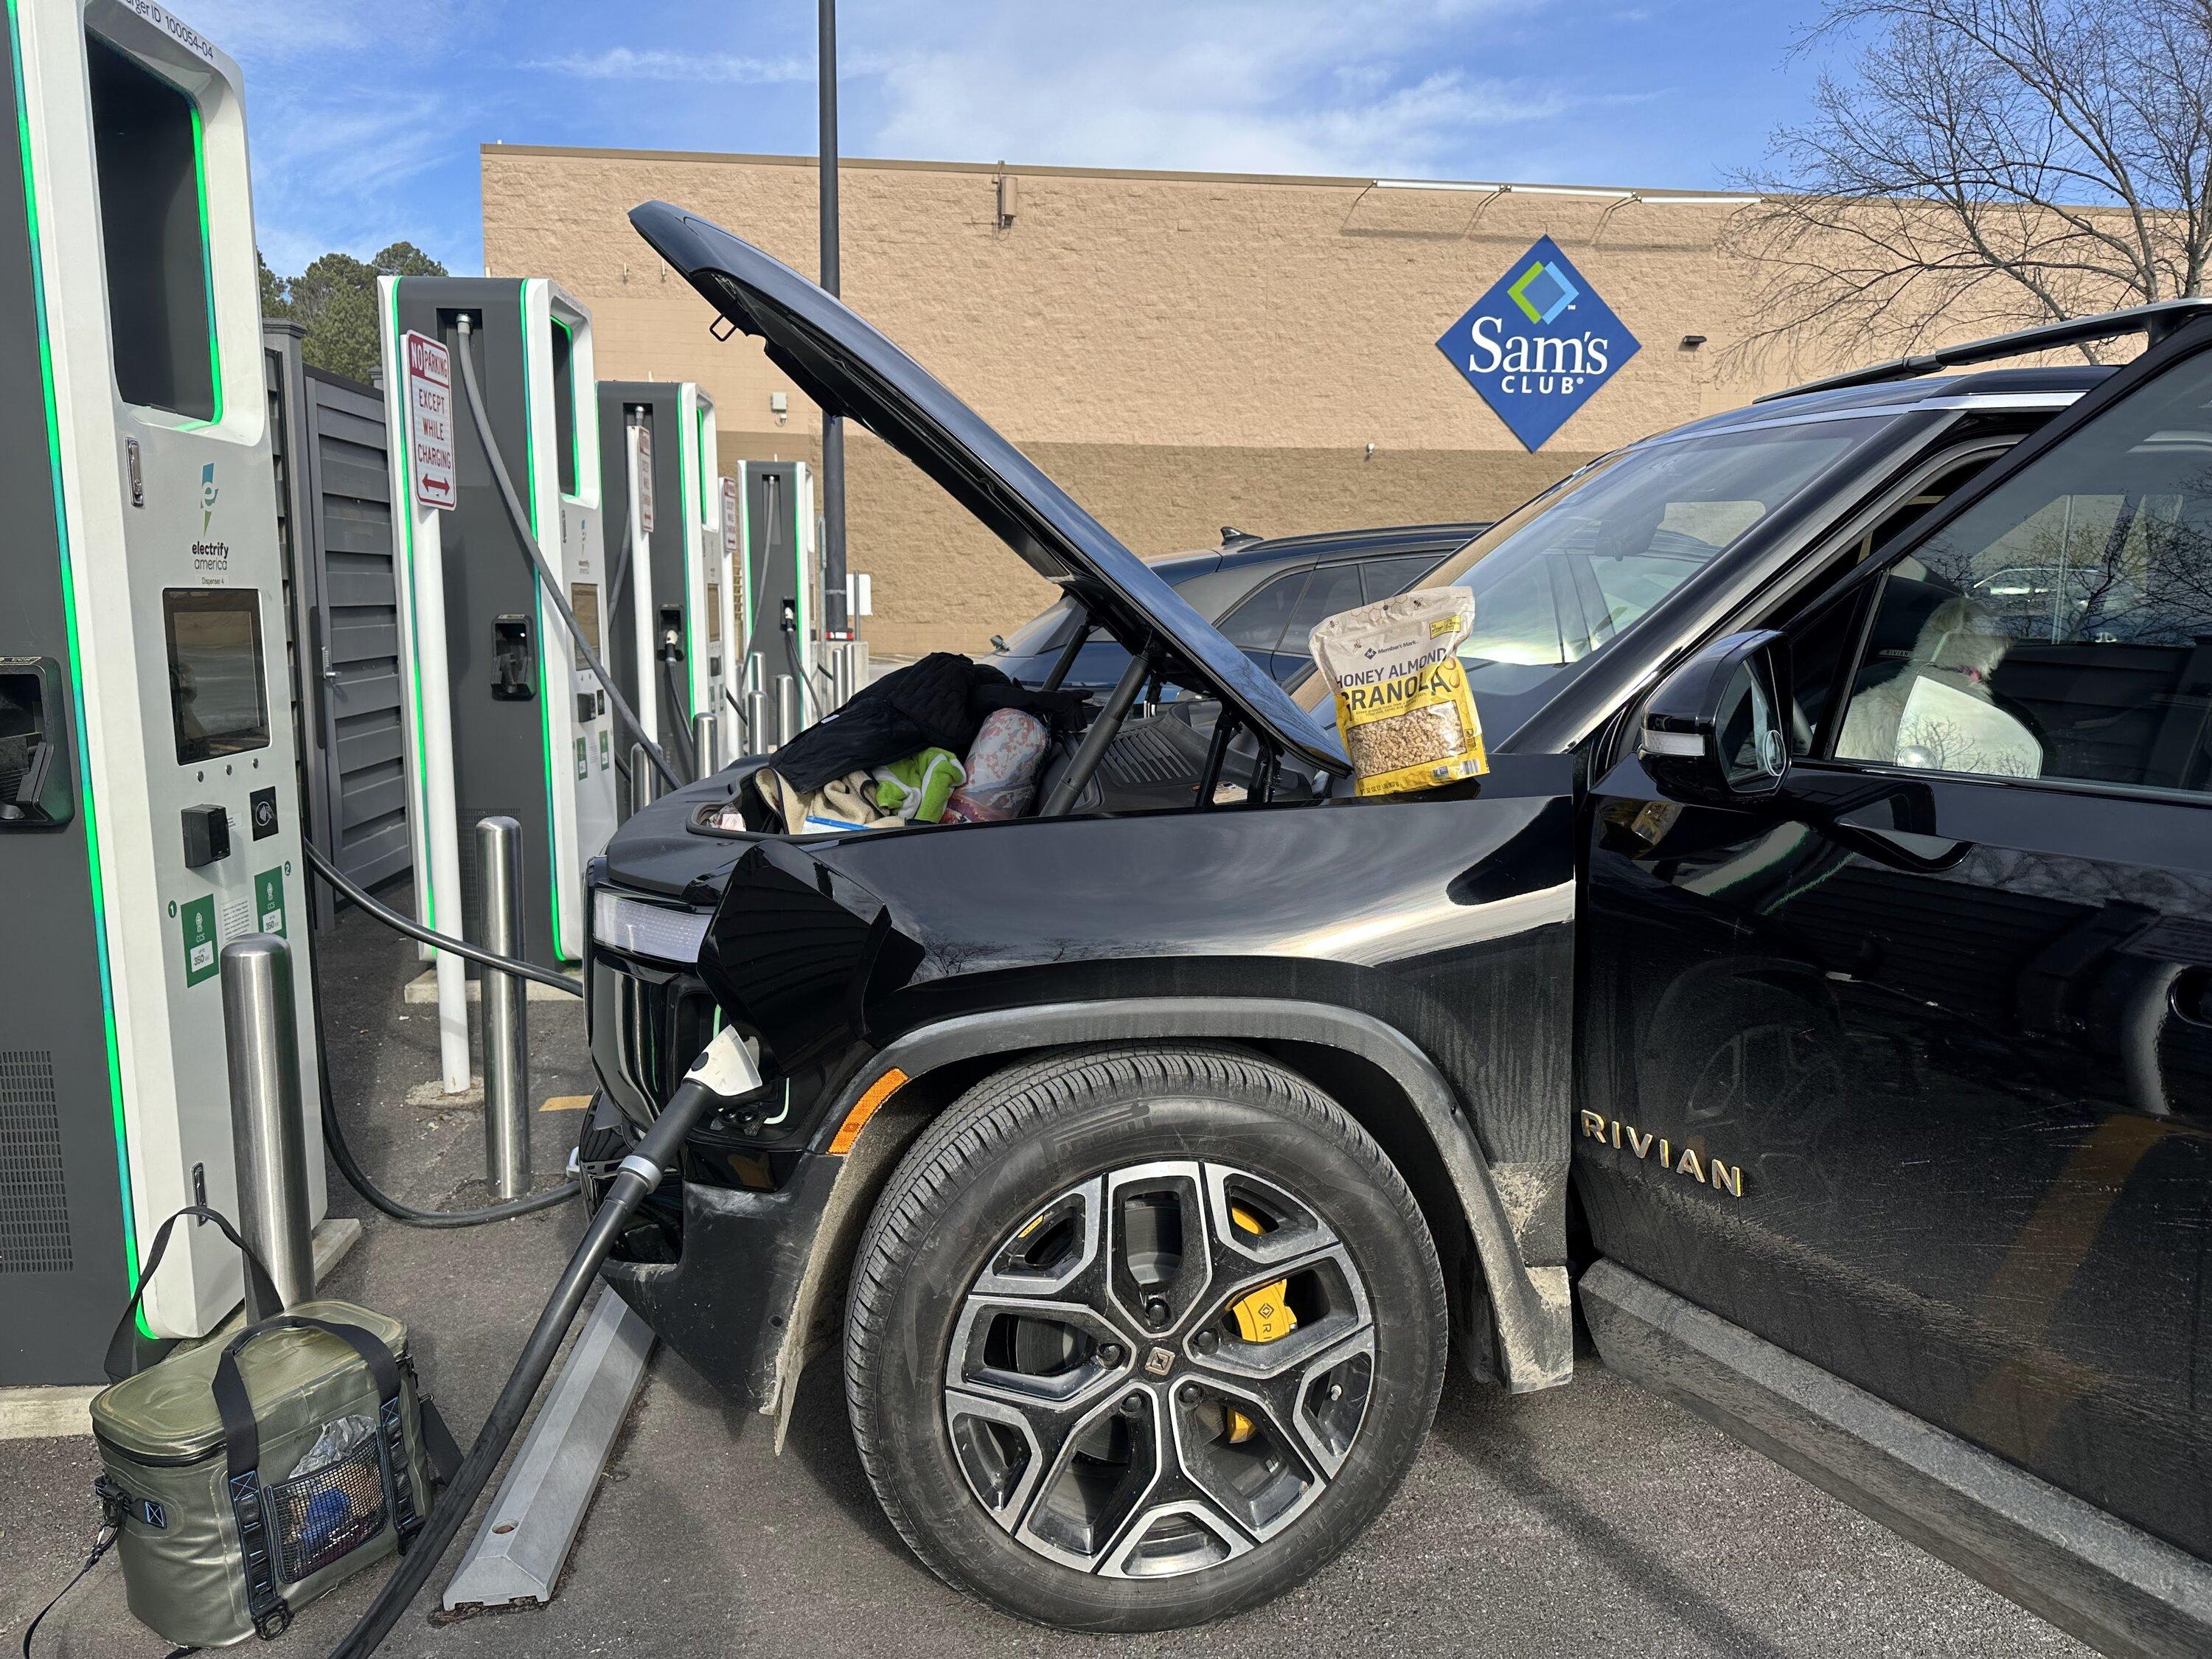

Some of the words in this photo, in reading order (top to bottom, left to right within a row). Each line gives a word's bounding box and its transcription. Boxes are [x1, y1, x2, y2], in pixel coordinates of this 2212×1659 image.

[151, 7, 161, 23] ID
[166, 15, 214, 60] 100054-04
[1469, 316, 1608, 375] Sam's
[411, 341, 423, 371] NO
[423, 349, 448, 378] PARKING
[419, 389, 445, 414] EXCEPT
[422, 417, 445, 442] WHILE
[417, 444, 451, 470] CHARGING
[192, 540, 229, 560] electrify
[194, 557, 227, 571] america
[1377, 643, 1402, 655] Member's
[1402, 640, 1416, 648] Mark
[1388, 647, 1447, 679] ALMOND
[285, 863, 291, 875] 2
[170, 904, 175, 917] 1
[267, 901, 276, 911] CCS
[265, 919, 275, 931] 350
[196, 933, 206, 943] CCS
[194, 954, 205, 966] 350
[1581, 1109, 1742, 1197] RIVIAN
